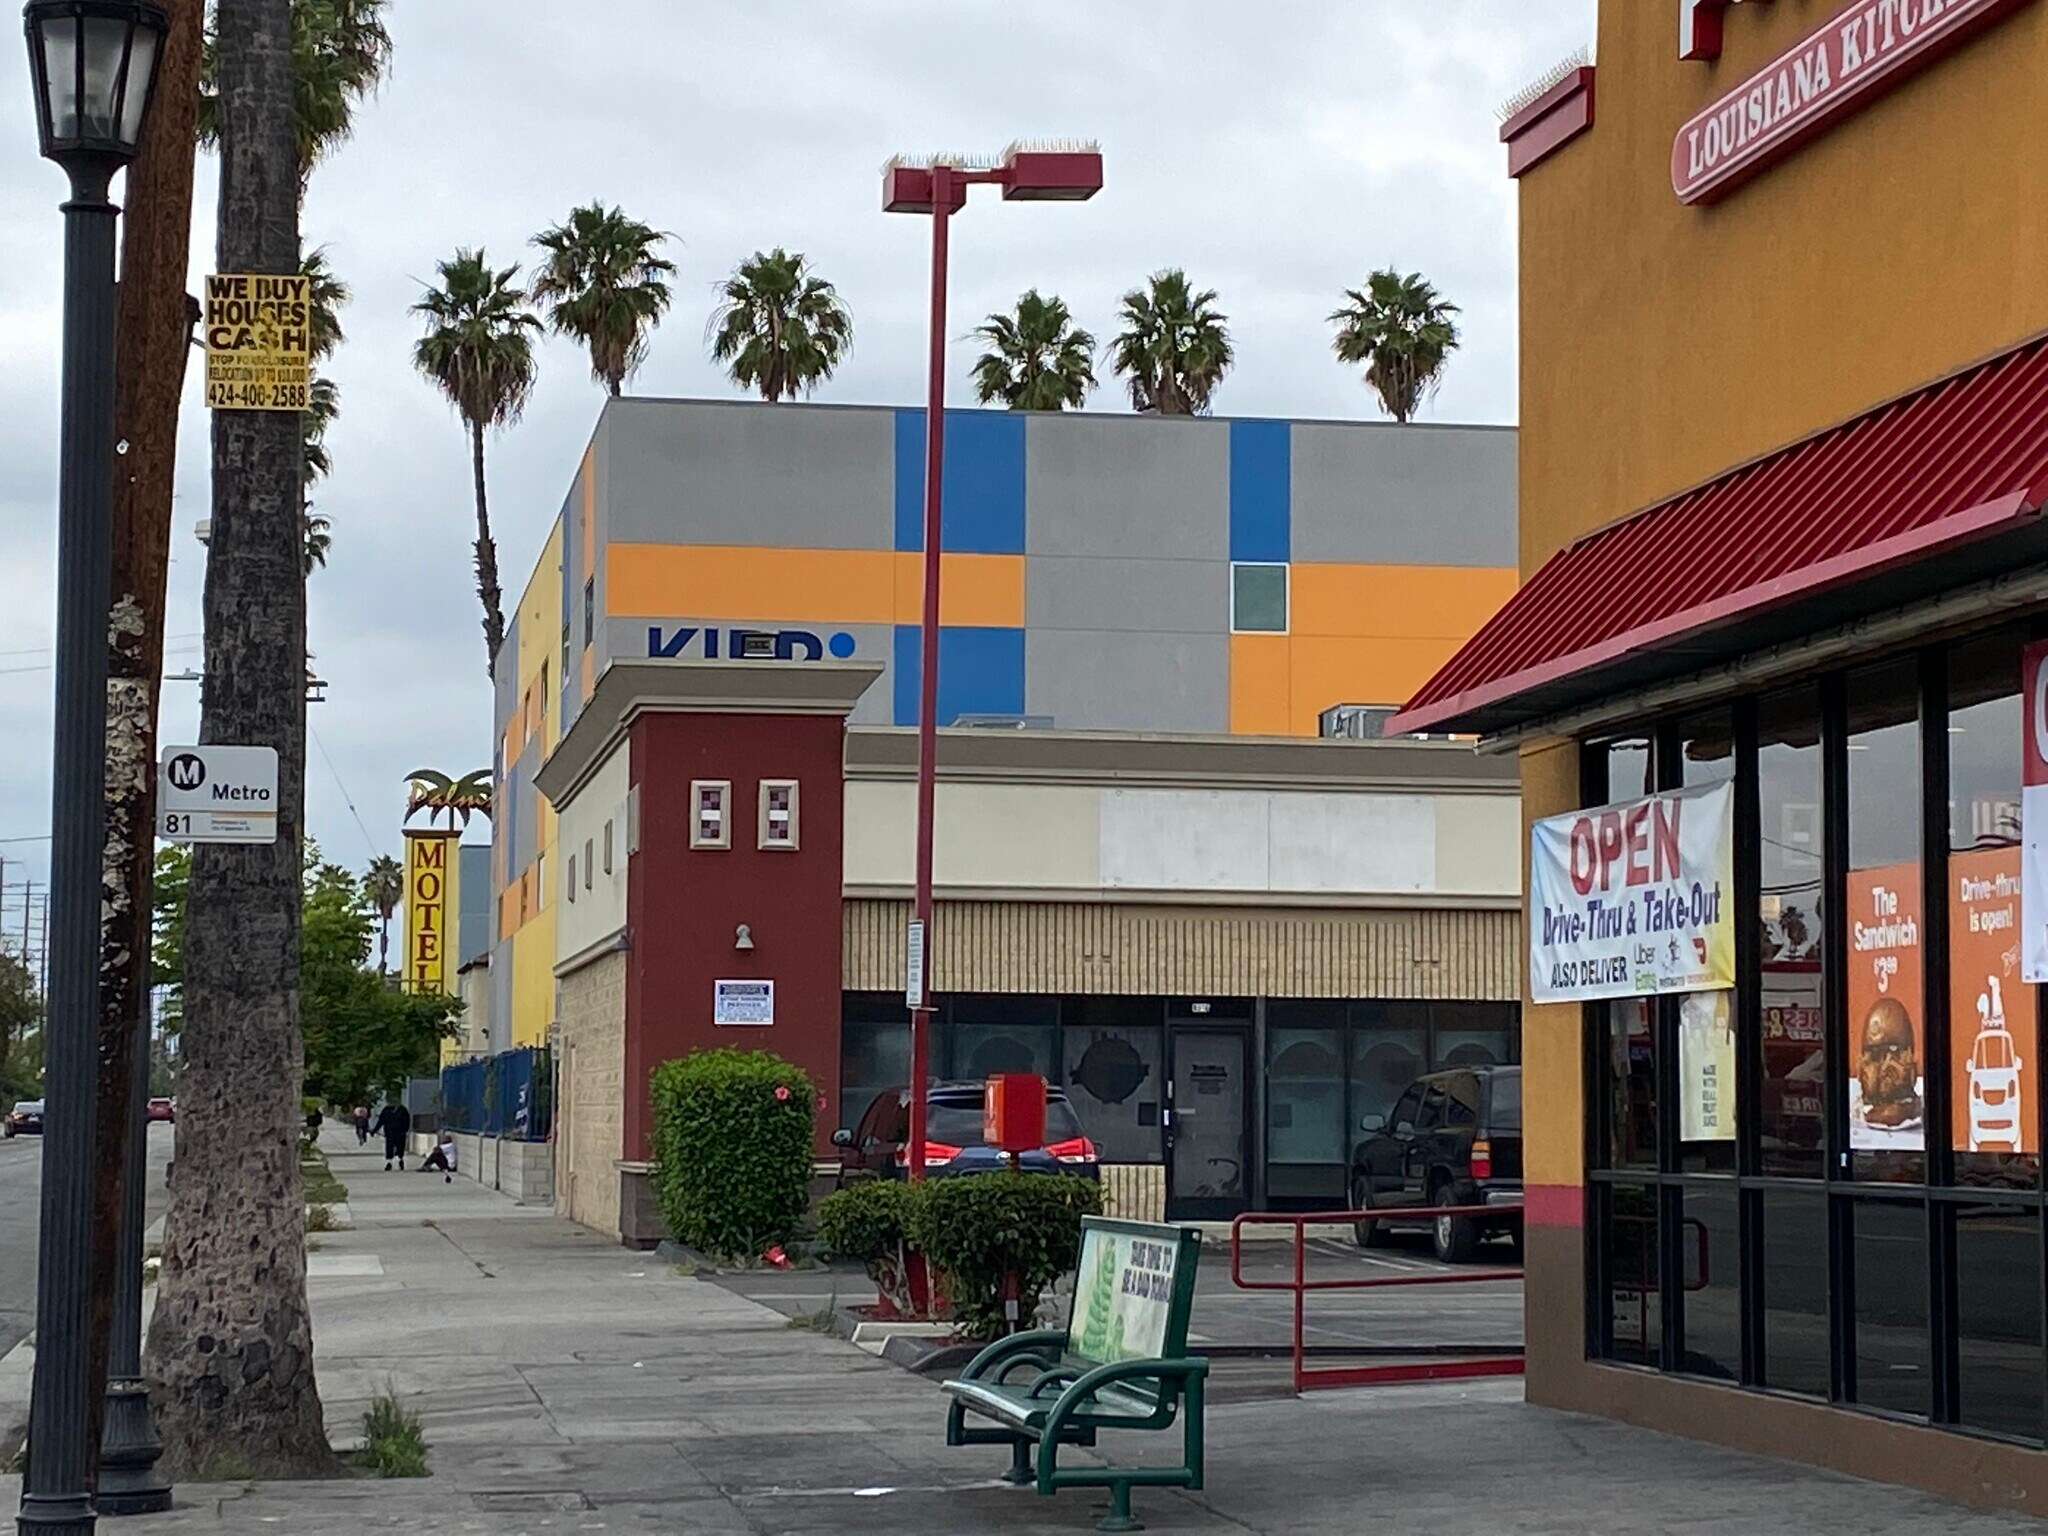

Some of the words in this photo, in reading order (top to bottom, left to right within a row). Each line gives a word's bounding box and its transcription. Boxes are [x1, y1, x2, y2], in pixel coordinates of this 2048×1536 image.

[1687, 41, 1832, 180] LOUISIANA
[208, 277, 248, 299] WE
[256, 278, 306, 300] BUY
[208, 300, 306, 327] HOUSES
[209, 354, 235, 365] STOP
[212, 783, 270, 801] Metro
[165, 814, 191, 834] 81
[1569, 797, 1682, 896] OPEN
[1543, 898, 1623, 947] Drive-Thru
[1626, 901, 1637, 936] &
[1644, 881, 1721, 932] Take-Out
[1872, 886, 1898, 917] The
[1854, 915, 1918, 951] Sandwich
[1969, 906, 1980, 933] is
[1981, 902, 2014, 936] open!
[1551, 961, 1577, 990] ALSO
[1580, 956, 1628, 987] DELIVER
